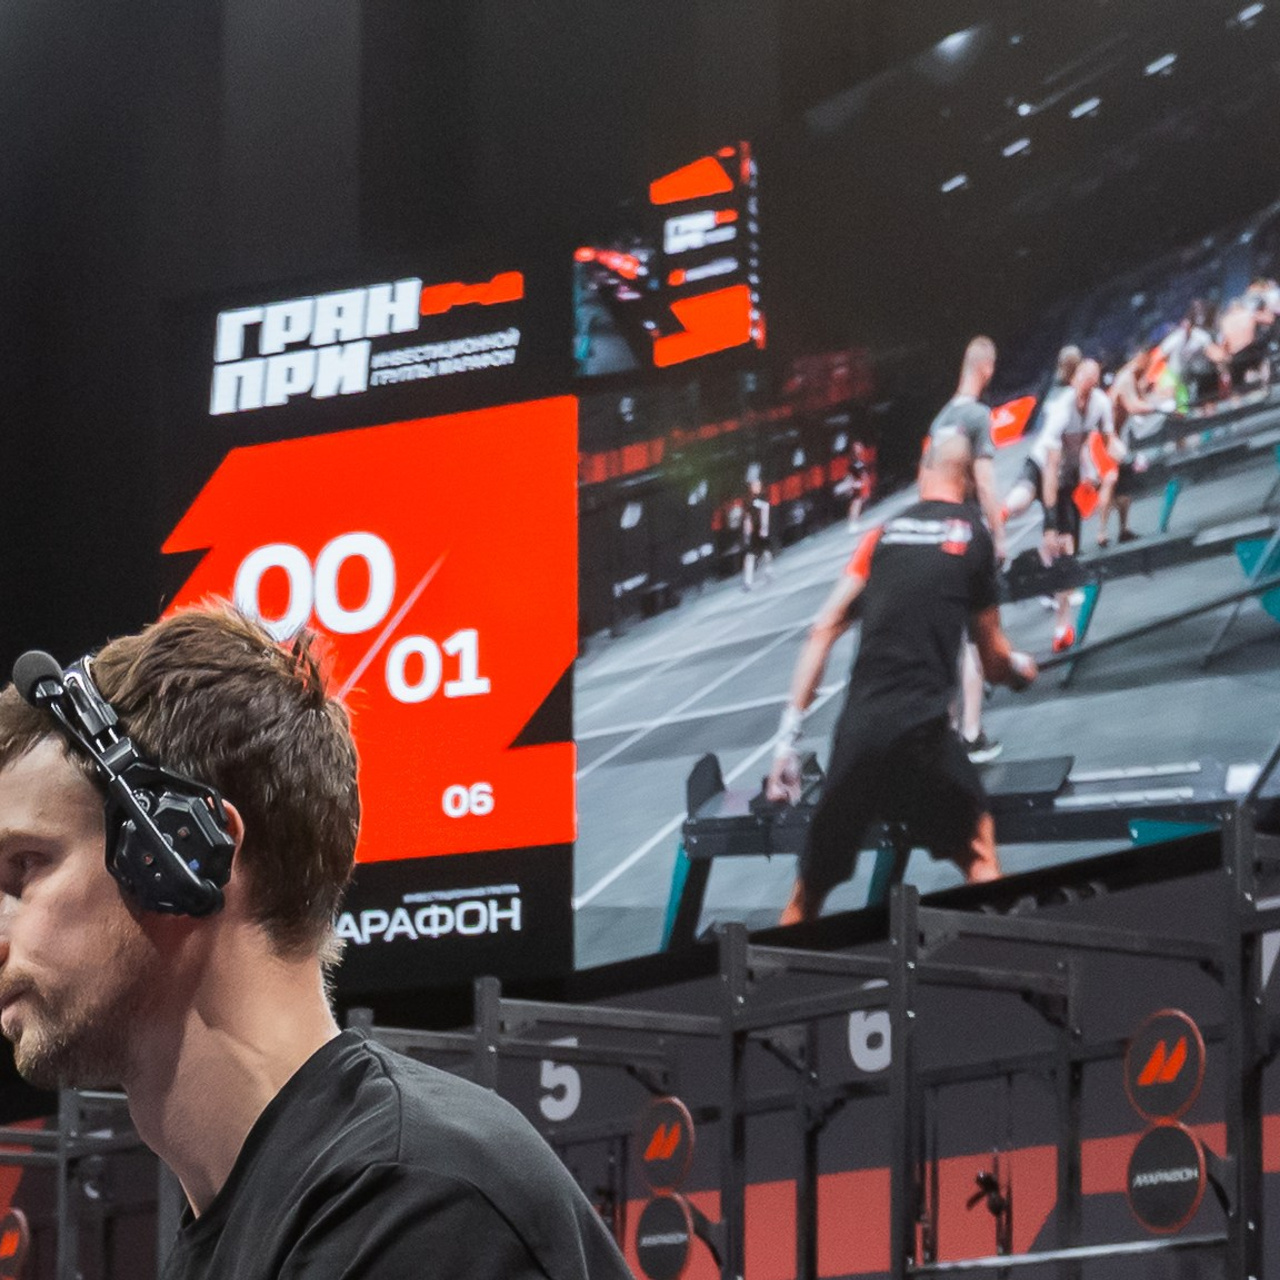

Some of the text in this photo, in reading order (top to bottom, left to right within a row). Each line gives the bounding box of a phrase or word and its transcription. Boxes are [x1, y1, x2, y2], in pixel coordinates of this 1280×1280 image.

[213, 276, 422, 363] ГРАН
[209, 339, 372, 416] ПРИ
[233, 530, 397, 642] 00
[384, 628, 491, 704] 01
[442, 781, 495, 819] 06
[335, 896, 522, 945] АРАФОН
[849, 978, 893, 1072] 6
[540, 1037, 582, 1122] 5
